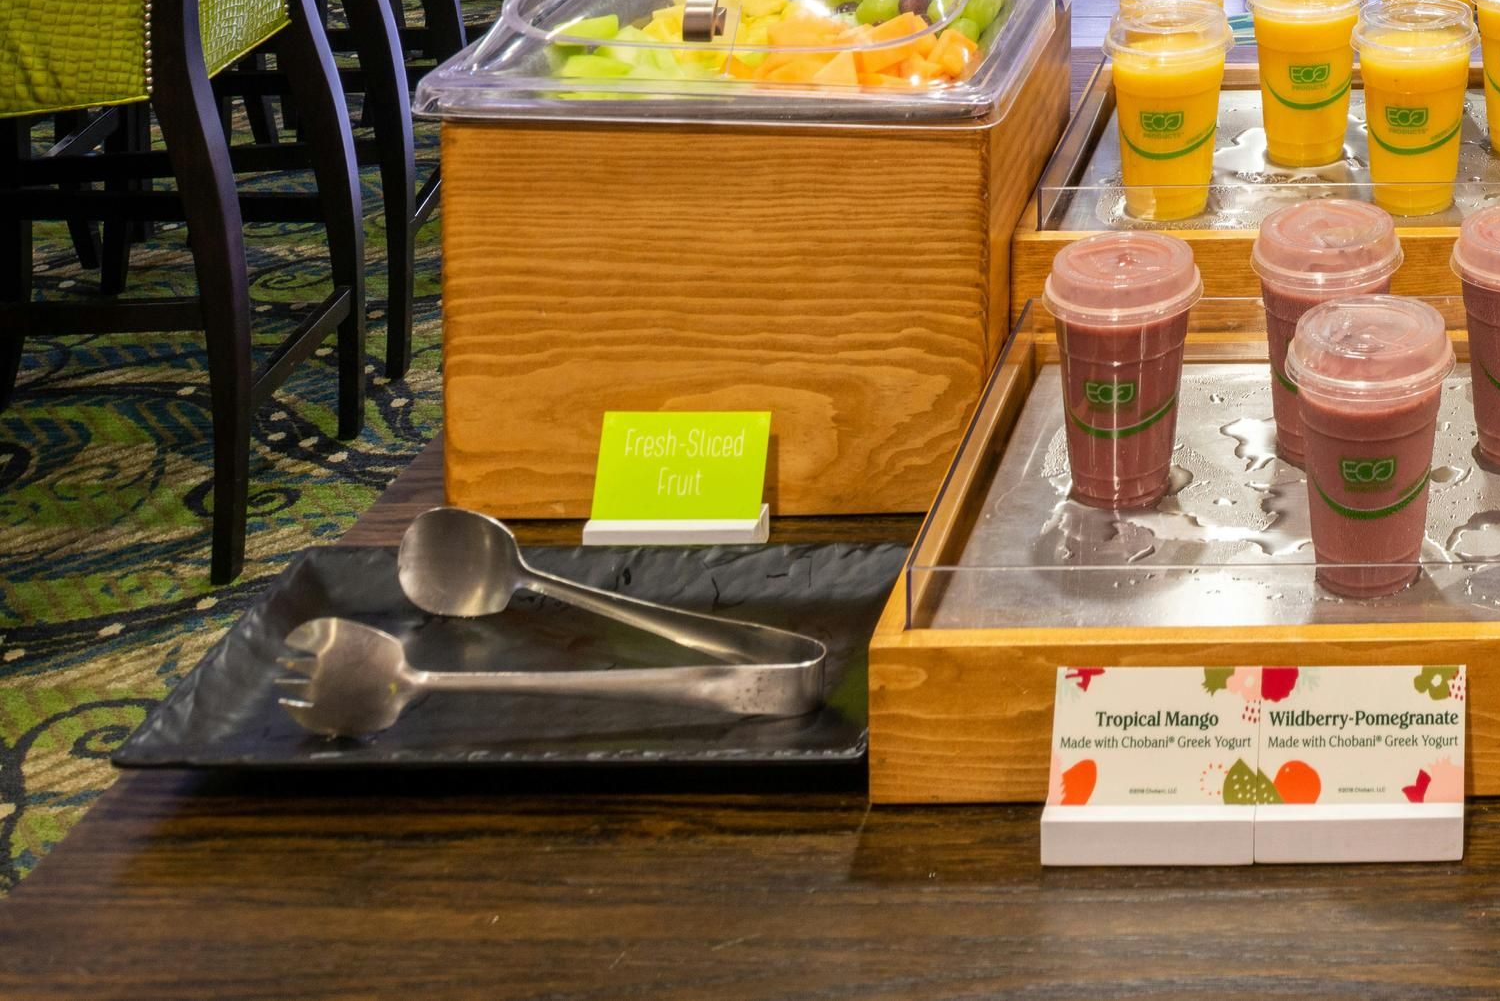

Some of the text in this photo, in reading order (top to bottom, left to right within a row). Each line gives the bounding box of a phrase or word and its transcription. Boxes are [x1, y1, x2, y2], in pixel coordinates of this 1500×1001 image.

[1290, 64, 1329, 83] ECO
[1141, 113, 1182, 131] ECO
[1386, 108, 1426, 126] ECO
[624, 427, 745, 458] Fresh-Sliced
[1341, 458, 1395, 483] ECO
[656, 466, 703, 497] Fruit
[1095, 710, 1219, 730] Tropical Mango
[1269, 709, 1459, 729] Wildberry-Pomegranate
[1060, 736, 1092, 749] Made
[1094, 736, 1119, 749] with
[1177, 735, 1211, 749] Greek
[1214, 735, 1252, 751] Yogurt
[1268, 735, 1300, 748] Made
[1302, 735, 1326, 748] with
[1384, 734, 1419, 748] Greek
[1421, 734, 1459, 750] Yogurt
